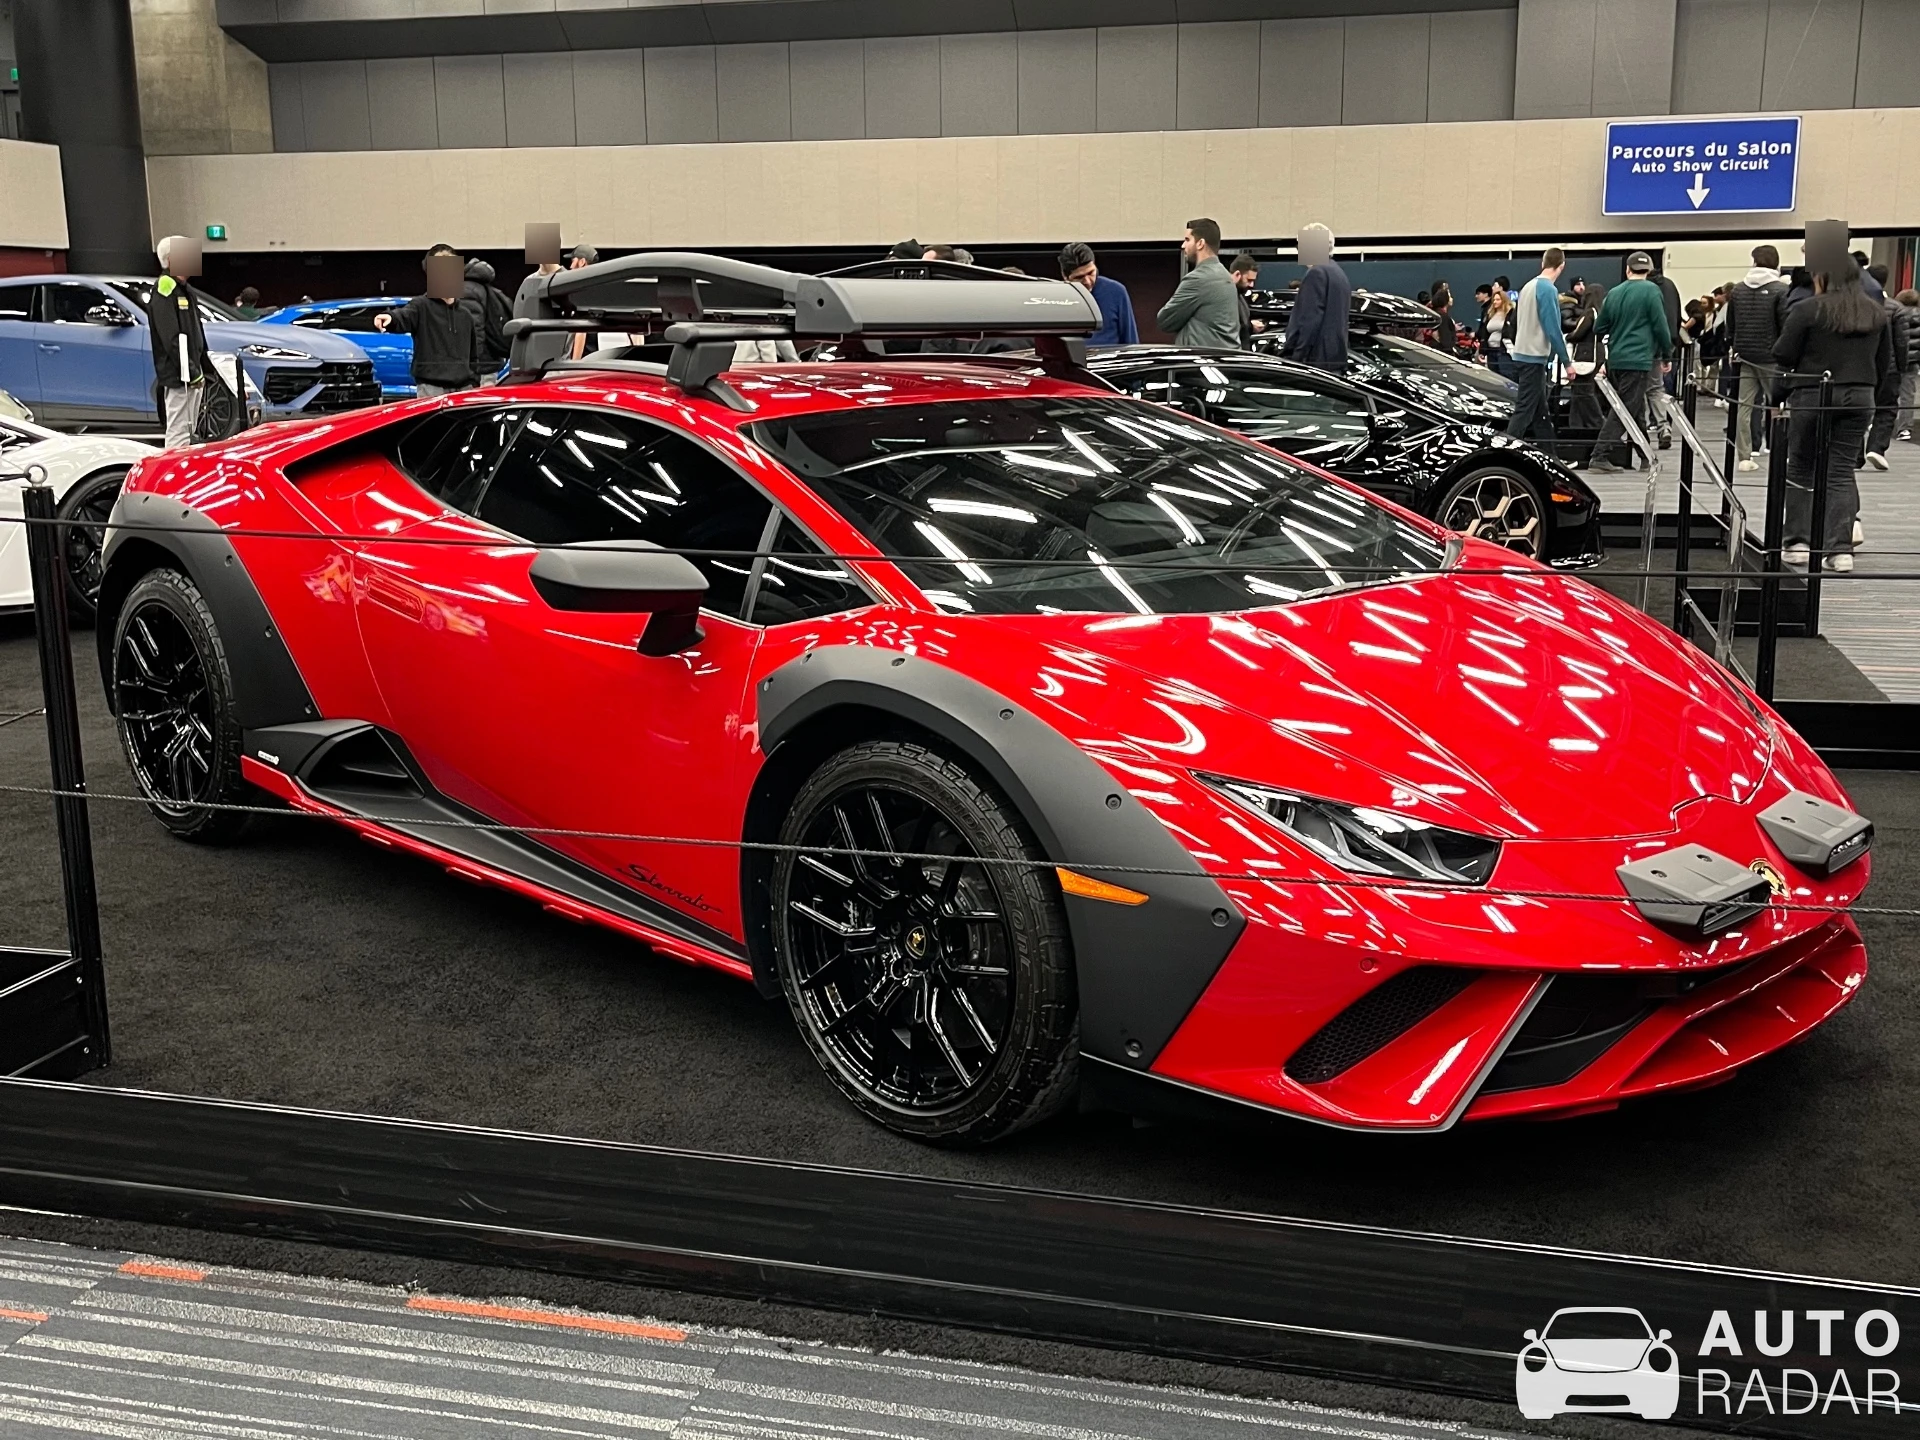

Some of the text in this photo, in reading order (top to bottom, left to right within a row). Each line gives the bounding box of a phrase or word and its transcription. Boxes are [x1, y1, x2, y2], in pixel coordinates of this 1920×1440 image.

[1612, 141, 1792, 159] Parcours du Salon
[1631, 158, 1769, 173] Auto Show Circuit
[615, 863, 724, 914] Sterrato
